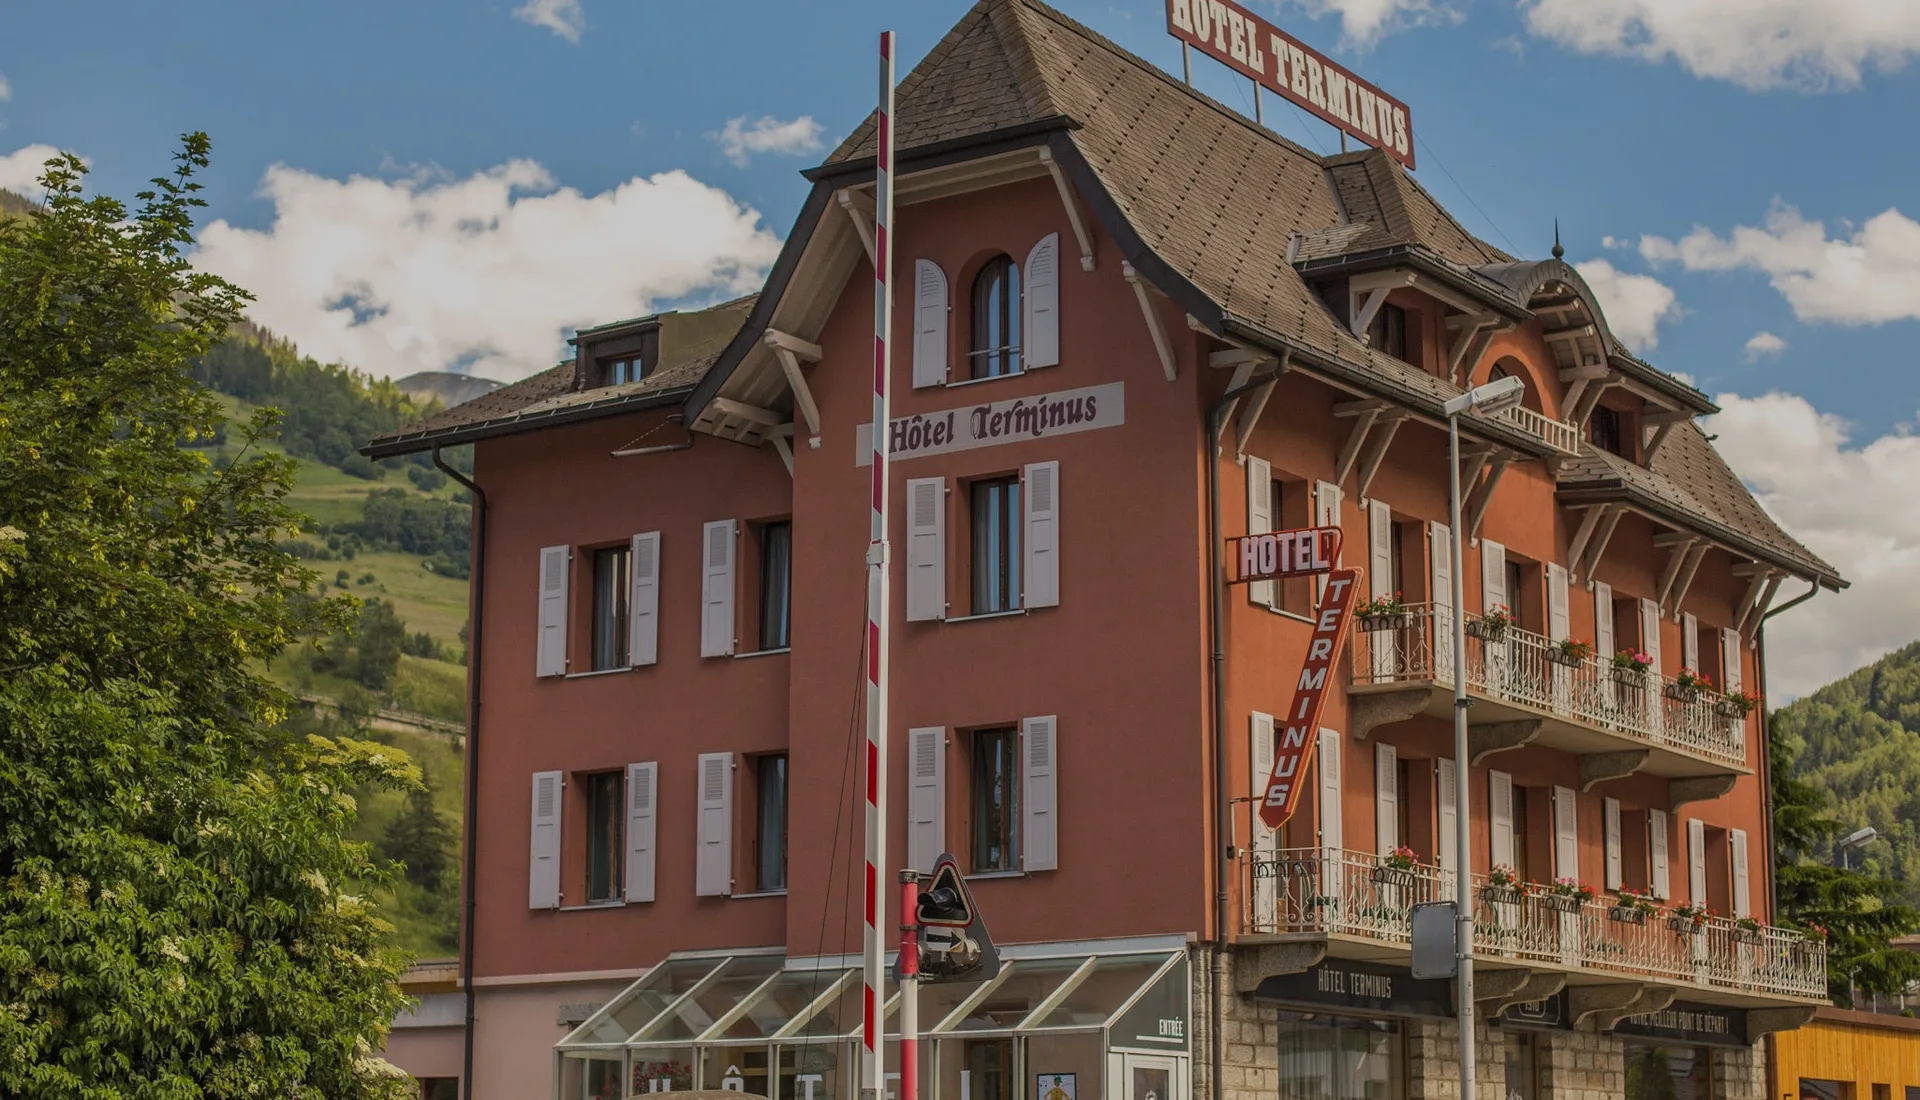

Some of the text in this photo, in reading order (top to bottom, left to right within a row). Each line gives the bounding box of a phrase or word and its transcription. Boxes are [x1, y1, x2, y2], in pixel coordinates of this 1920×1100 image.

[1172, 0, 1409, 157] HOTEL TERMINUS
[889, 396, 1097, 453] Hôtel Terminus
[1240, 529, 1329, 577] HOTEL
[1265, 579, 1351, 807] TERMINUS
[1318, 964, 1392, 998] HÔTEL TERMINUS
[1159, 1016, 1184, 1037] ENTRÉE
[1678, 1011, 1695, 1031] POINT
[1696, 1013, 1704, 1032] DE
[1704, 1010, 1725, 1034] DÉPART
